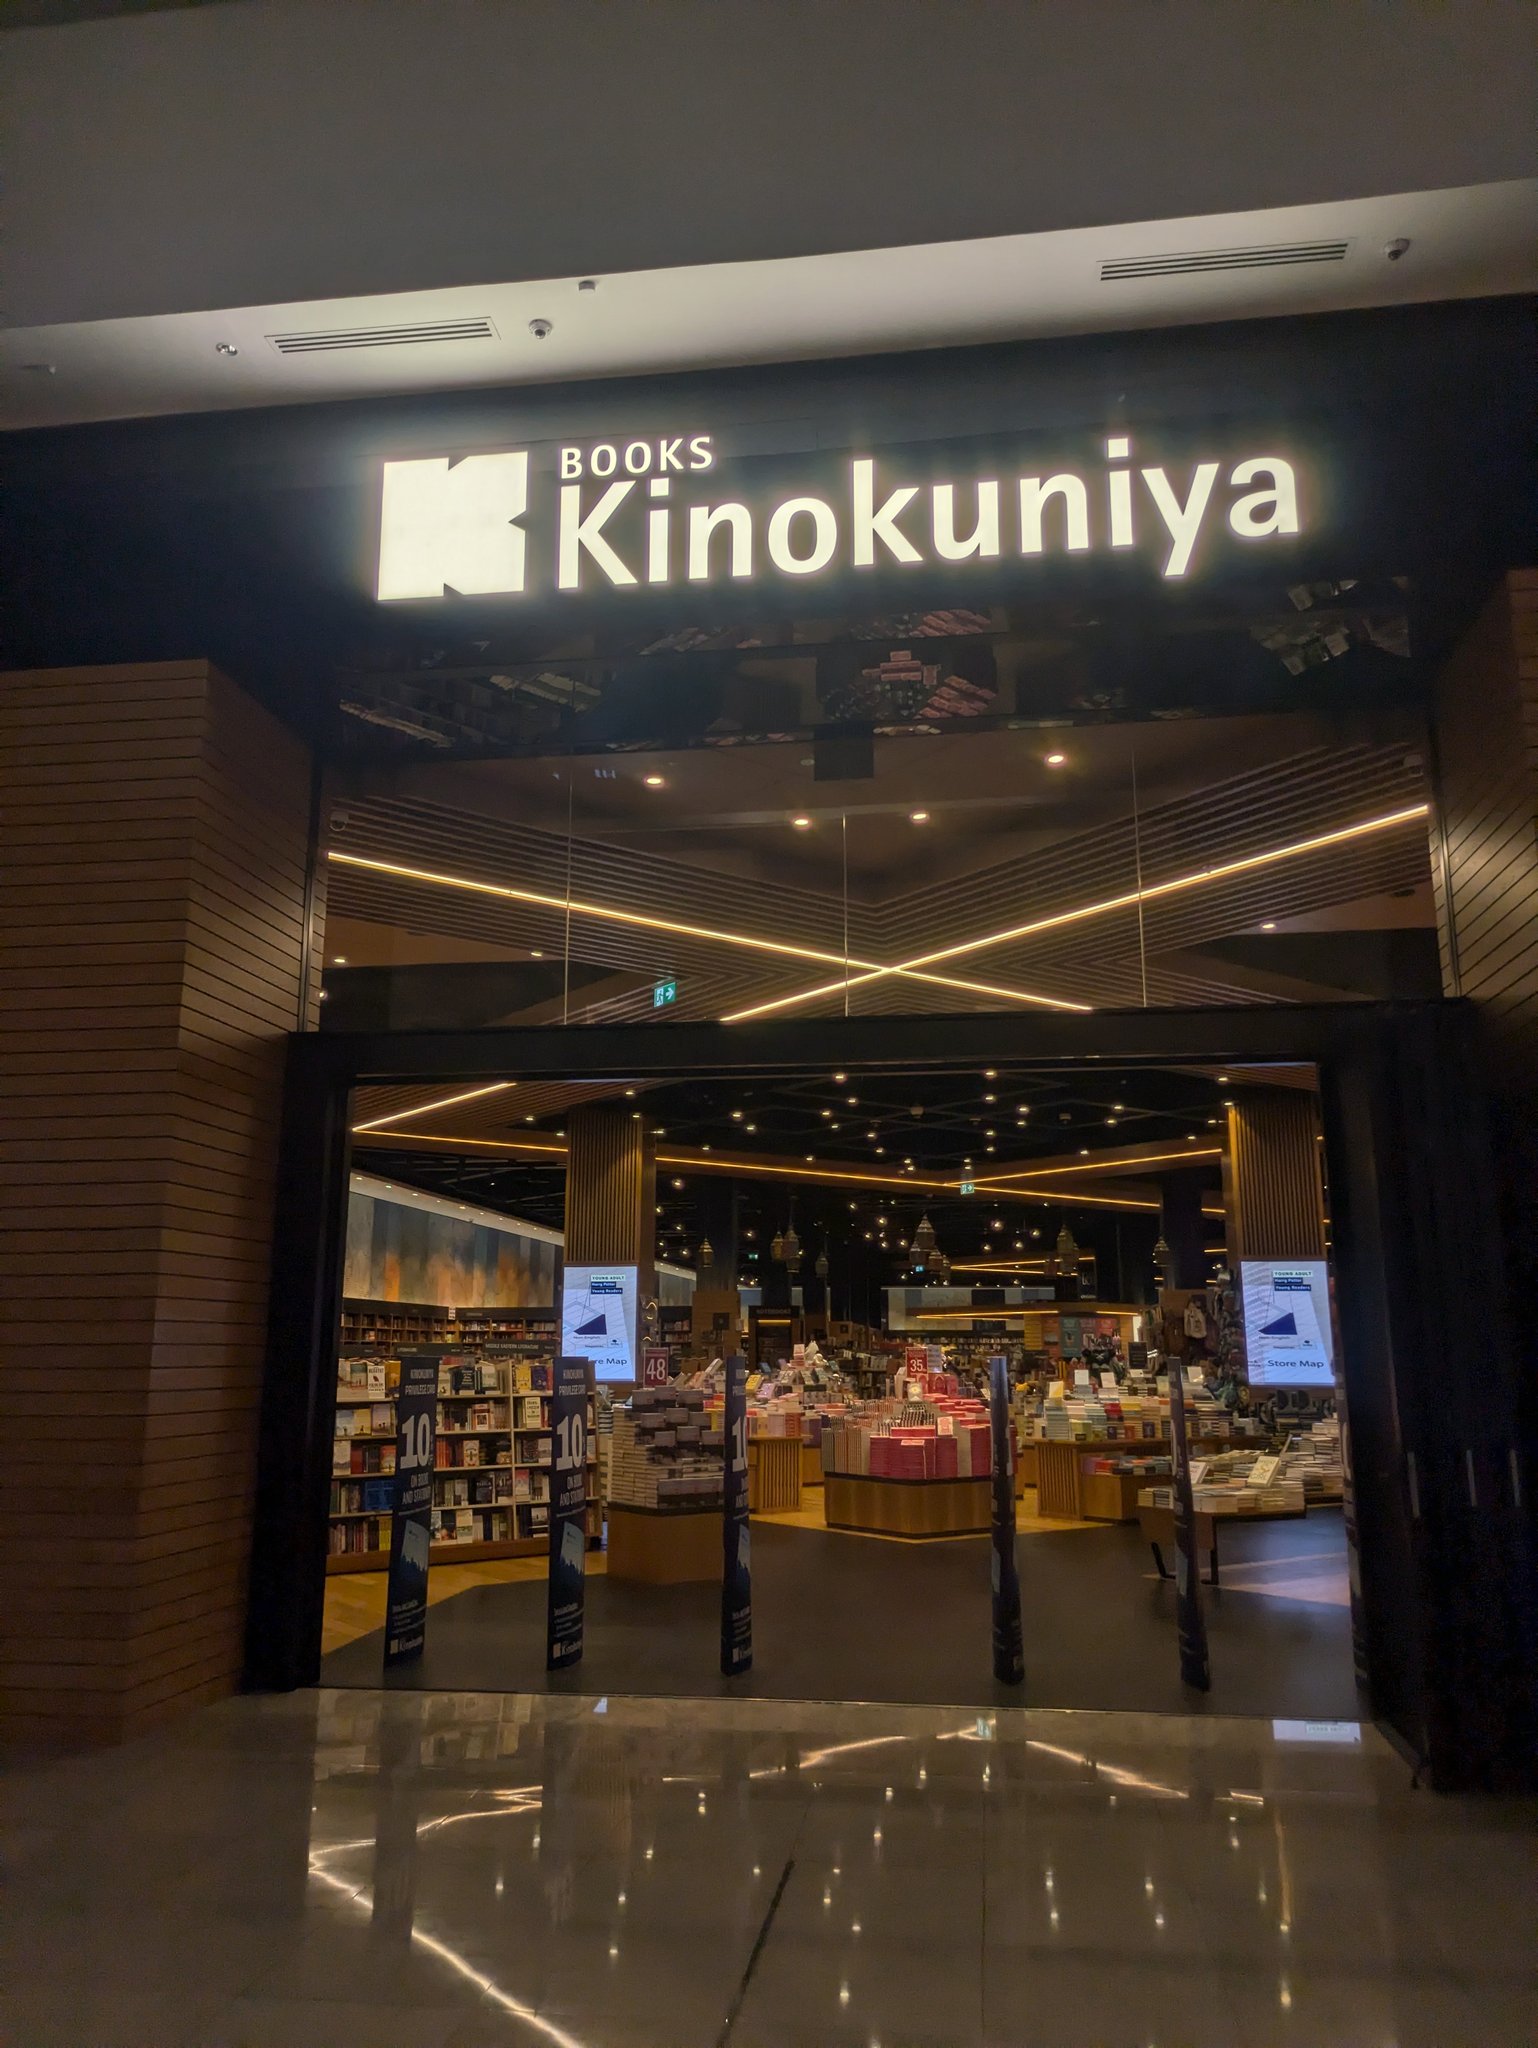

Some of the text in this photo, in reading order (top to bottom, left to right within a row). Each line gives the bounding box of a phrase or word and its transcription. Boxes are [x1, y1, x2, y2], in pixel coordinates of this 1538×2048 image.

[560, 437, 714, 480] BOOKS
[557, 436, 1300, 590] Kinokuniya
[646, 1358, 666, 1380] 48
[910, 1359, 923, 1372] 35
[1267, 1359, 1297, 1368] Store
[1299, 1360, 1325, 1369] Map
[400, 1412, 431, 1470] 10
[556, 1413, 584, 1471] 10
